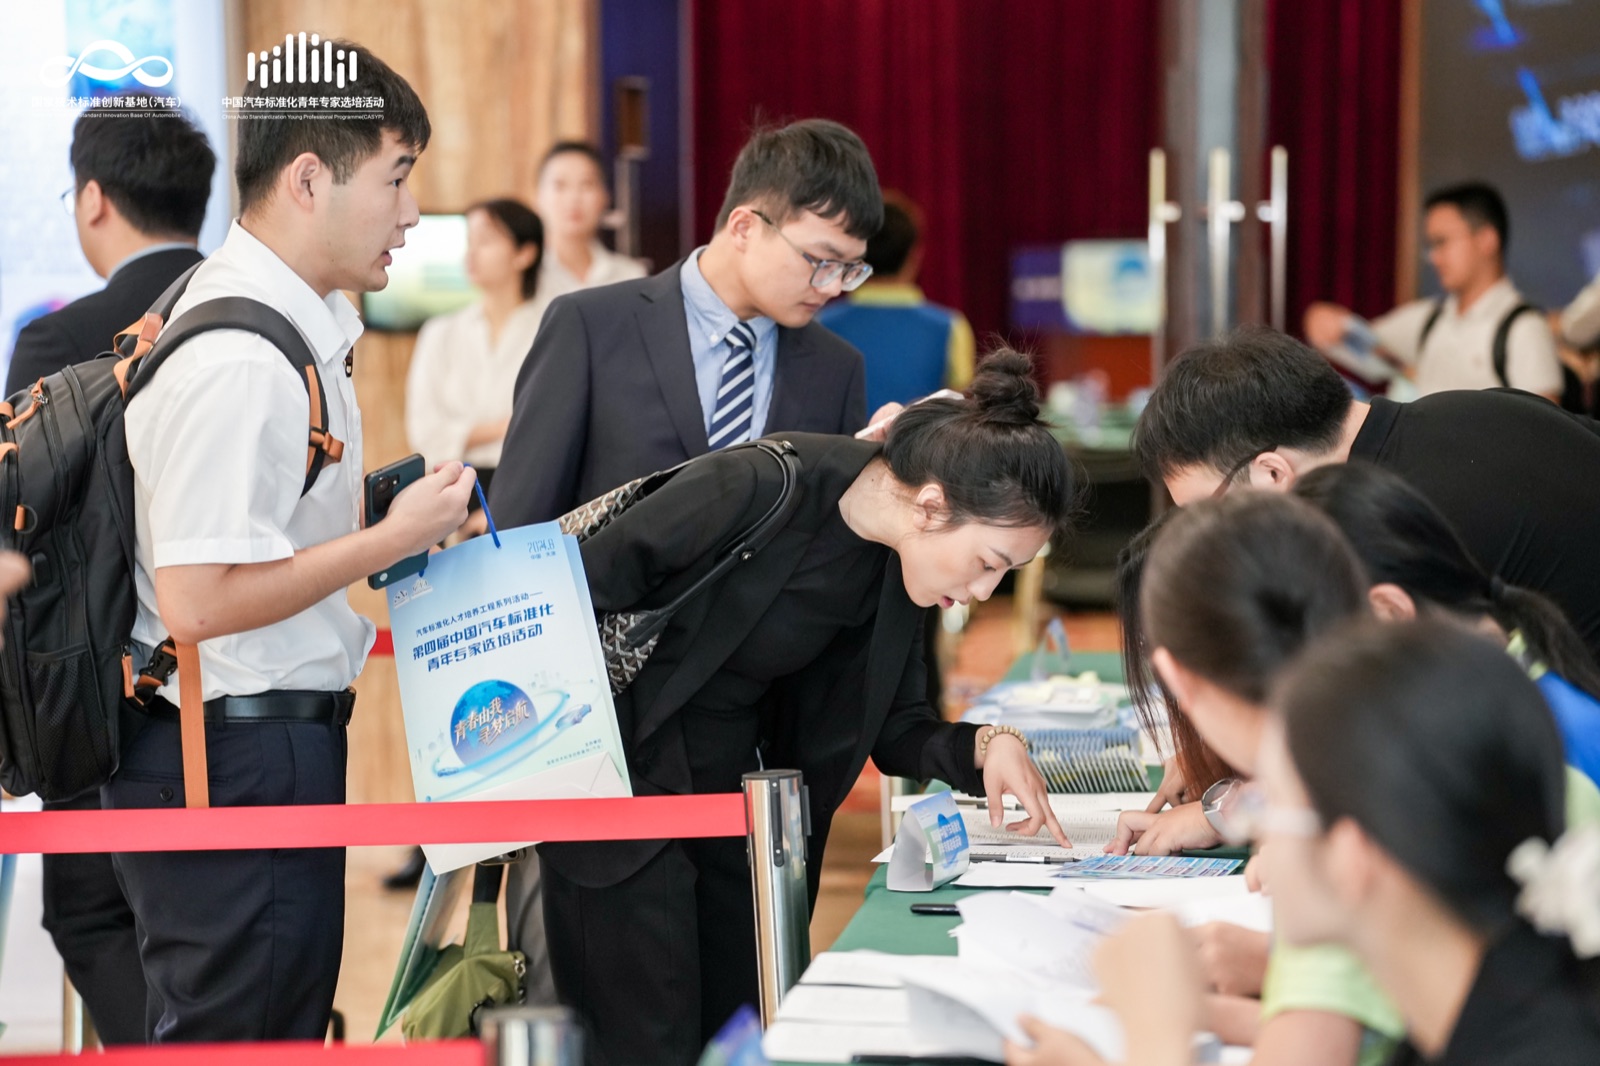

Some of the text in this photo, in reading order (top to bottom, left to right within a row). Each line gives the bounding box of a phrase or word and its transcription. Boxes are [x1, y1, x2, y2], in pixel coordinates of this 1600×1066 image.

[413, 603, 555, 661] 第四届中国汽车标准化
[427, 623, 543, 672] 青年专家选培活动
